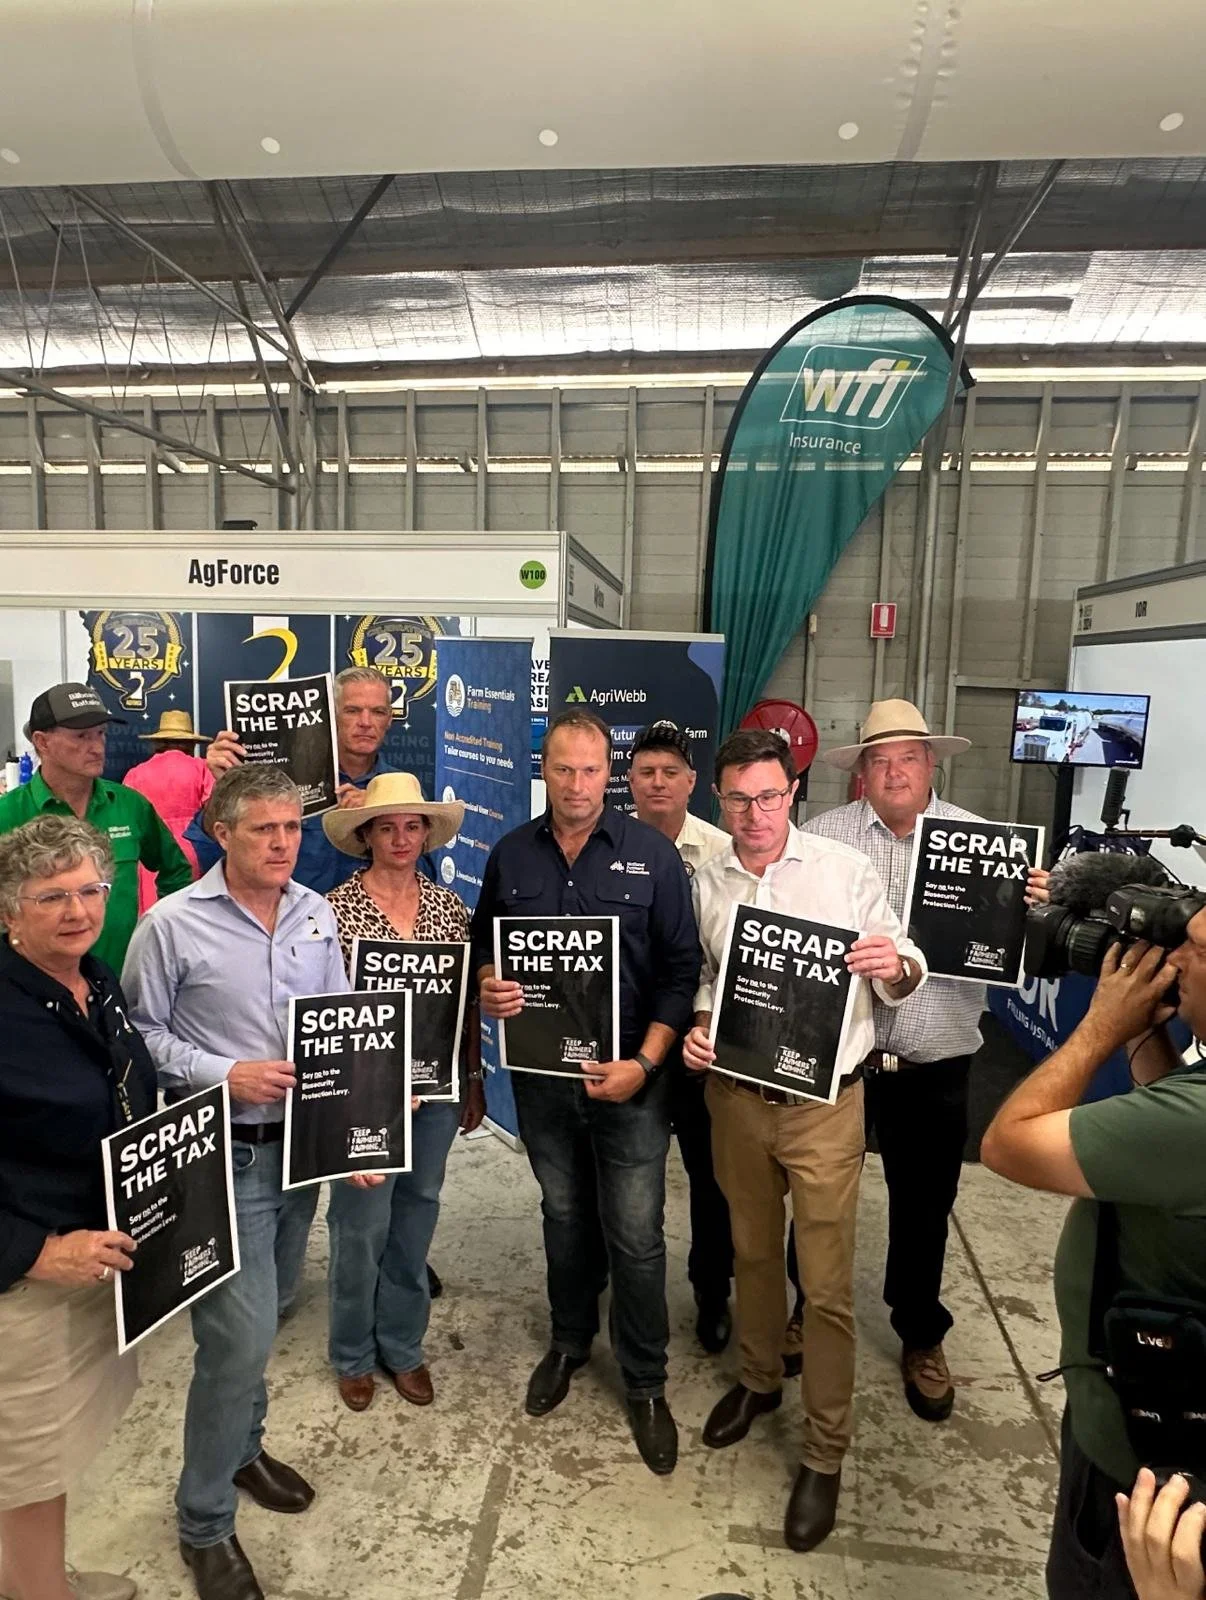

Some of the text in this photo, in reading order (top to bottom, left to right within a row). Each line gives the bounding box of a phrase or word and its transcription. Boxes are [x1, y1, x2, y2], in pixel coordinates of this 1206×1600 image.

[803, 358, 911, 418] wfi
[188, 559, 280, 587] AgForce
[519, 569, 546, 581] W100
[112, 625, 159, 659] 25
[374, 632, 424, 667] 25
[114, 659, 159, 669] YEARS
[236, 688, 320, 713] SCRAP
[467, 685, 515, 701] Farm Essentials
[590, 688, 647, 706] AgriWebb
[236, 709, 323, 732] THE TAX
[928, 830, 1027, 859] SCRAP
[925, 854, 1025, 881] THE TAX
[925, 881, 937, 890] Say
[923, 899, 955, 909] Protection
[508, 930, 603, 951] SCRAP
[741, 919, 845, 961] SCRAP
[364, 951, 455, 974] SCRAP
[508, 956, 604, 971] THE TAX
[738, 945, 842, 986] THE TAX
[363, 976, 453, 994] THE TAX
[735, 984, 771, 1000] Biosecurity
[737, 975, 749, 985] Say
[767, 983, 778, 991] the
[734, 993, 767, 1008] Protection
[300, 1004, 395, 1034] SCRAP
[300, 1031, 395, 1058] THE TAX
[302, 1072, 313, 1080] Say
[302, 1090, 332, 1101] Protection
[120, 1104, 215, 1173] SCRAP
[121, 1132, 217, 1200] THE TAX
[129, 1213, 142, 1225] Say
[158, 1196, 168, 1206] the
